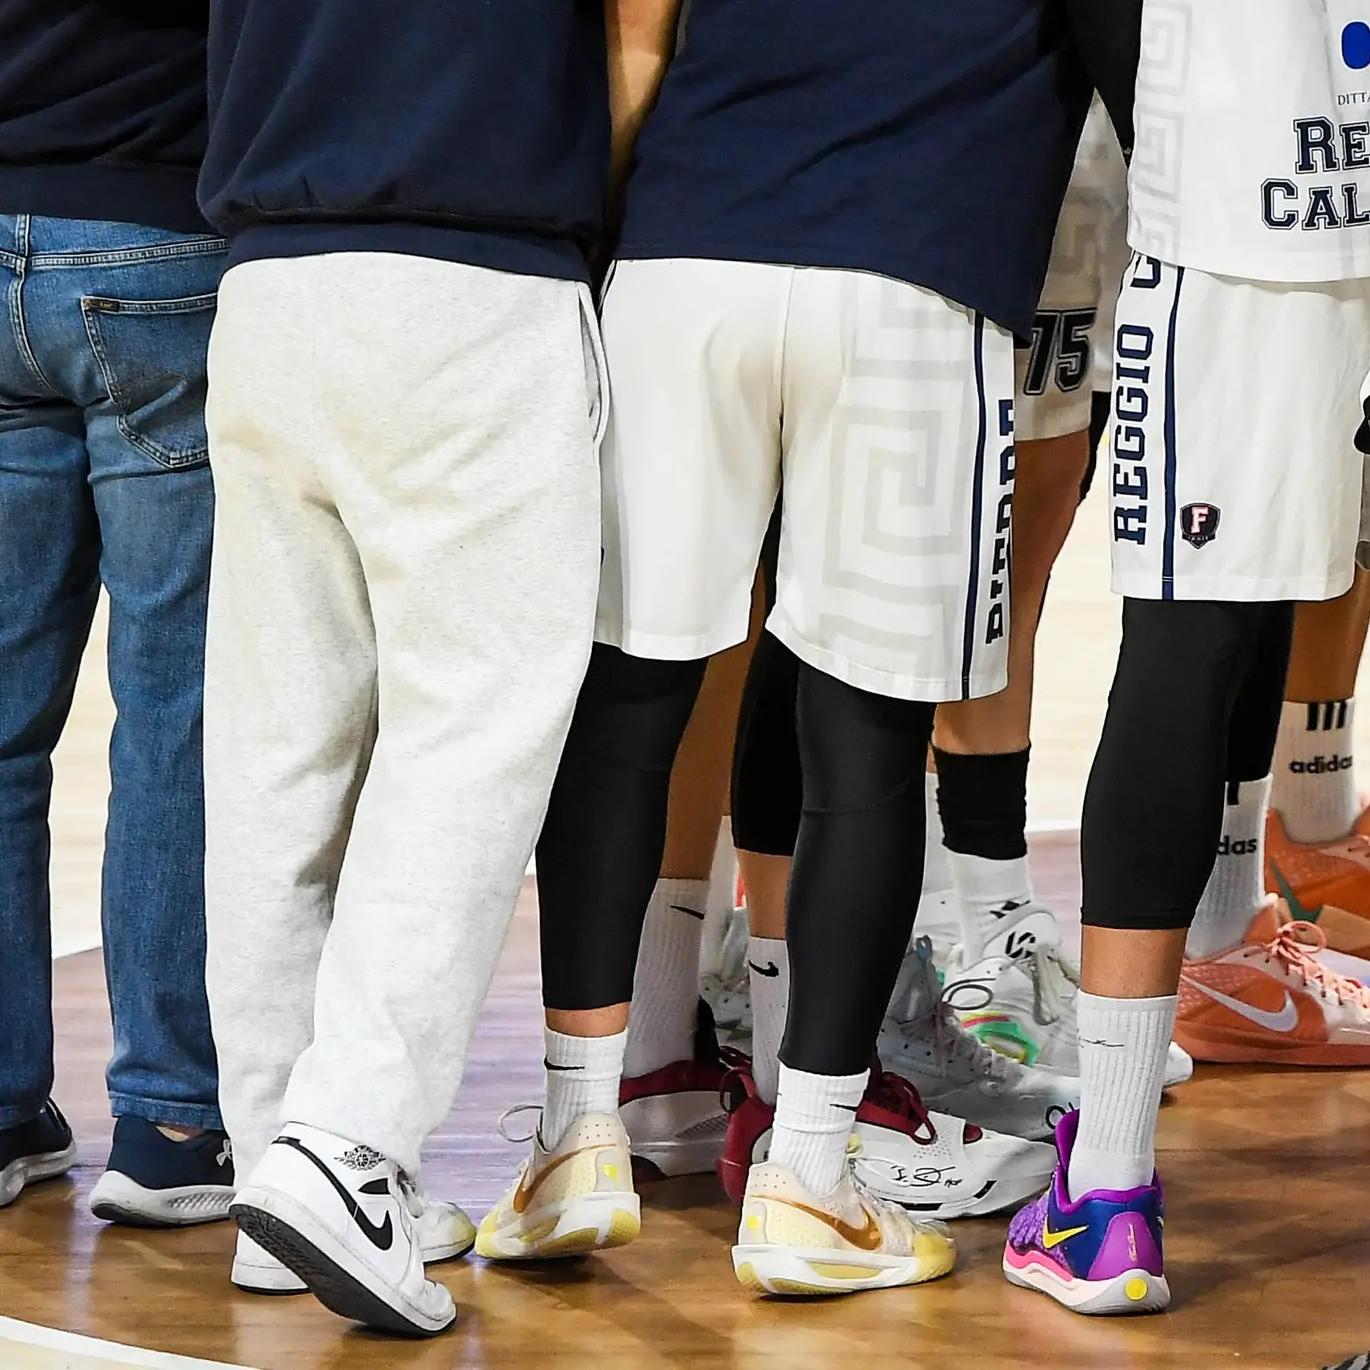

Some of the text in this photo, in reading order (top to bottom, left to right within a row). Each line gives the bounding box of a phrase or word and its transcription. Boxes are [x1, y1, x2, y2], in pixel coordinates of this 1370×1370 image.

[1023, 306, 1097, 396] 75
[1114, 323, 1155, 545] REGGIO
[1190, 506, 1209, 534] F
[1289, 755, 1354, 775] adida
[1217, 835, 1258, 856] das
